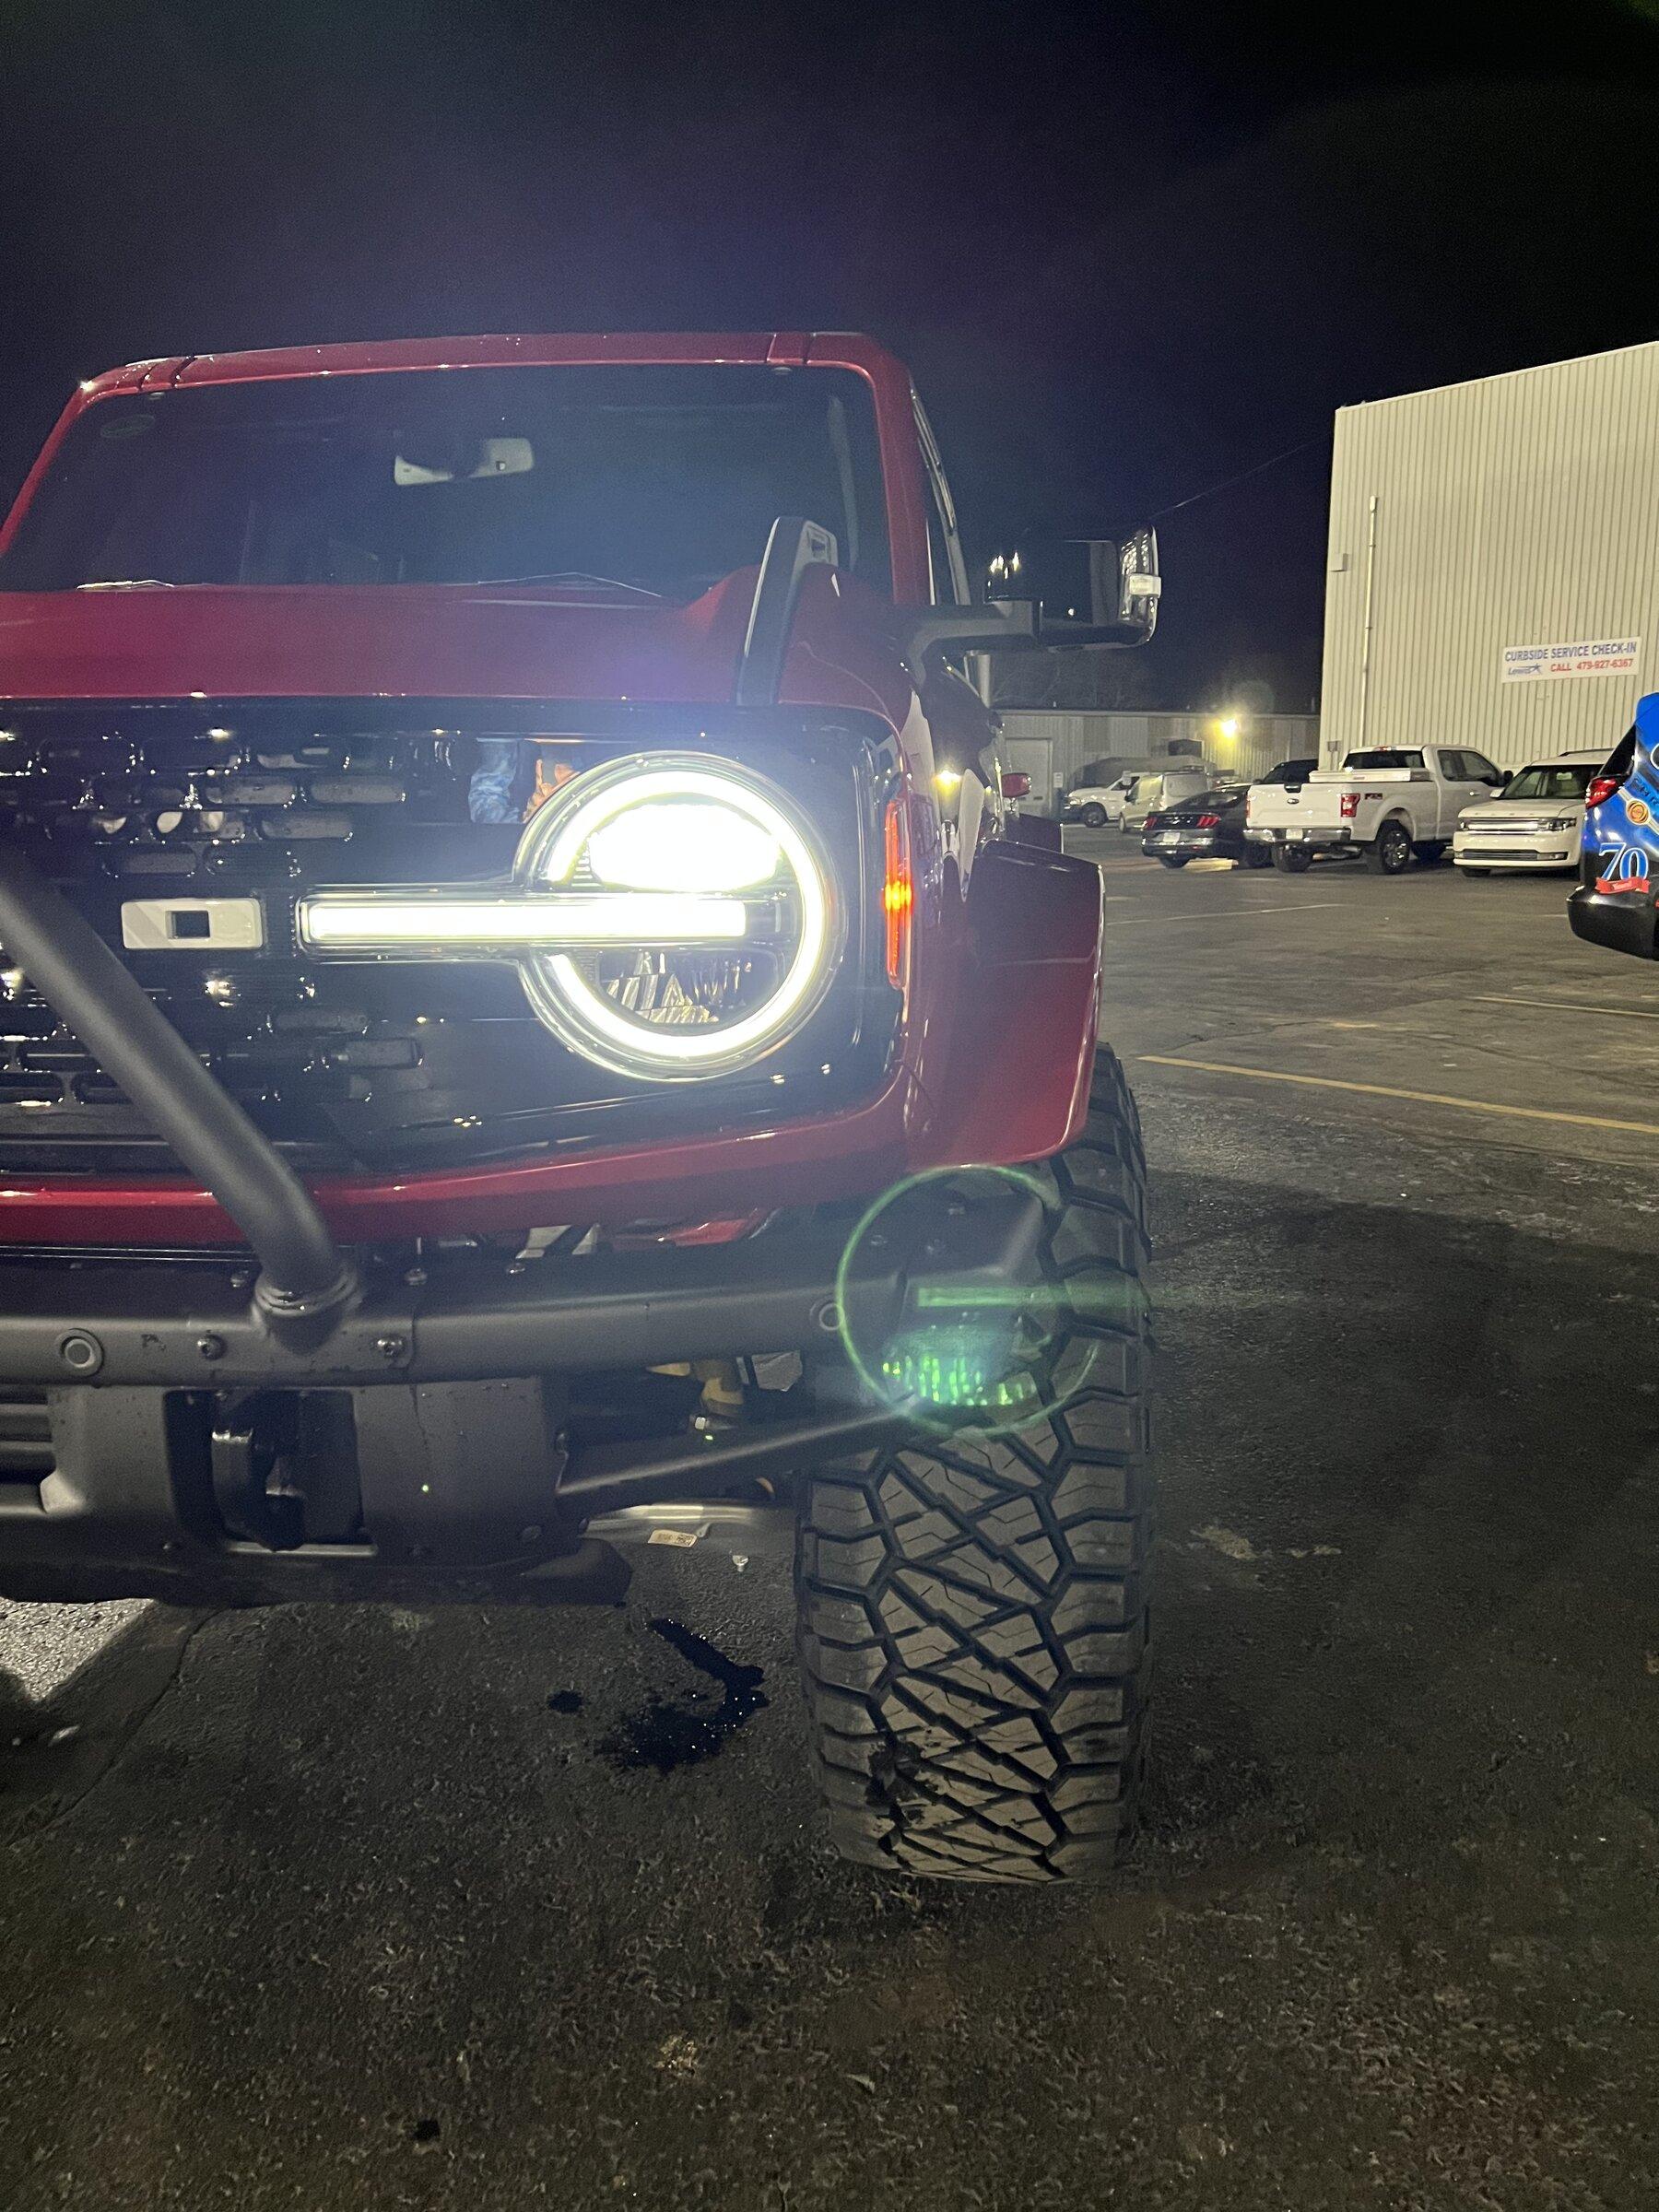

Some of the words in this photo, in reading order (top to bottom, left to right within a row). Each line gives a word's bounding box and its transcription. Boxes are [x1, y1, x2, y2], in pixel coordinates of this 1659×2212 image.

[1505, 648, 1548, 662] CURBSIDE
[1551, 645, 1589, 659] SERVICE
[1592, 641, 1637, 655] CHECK-IN
[1550, 663, 1571, 672] CALL
[1598, 842, 1648, 881] 70
